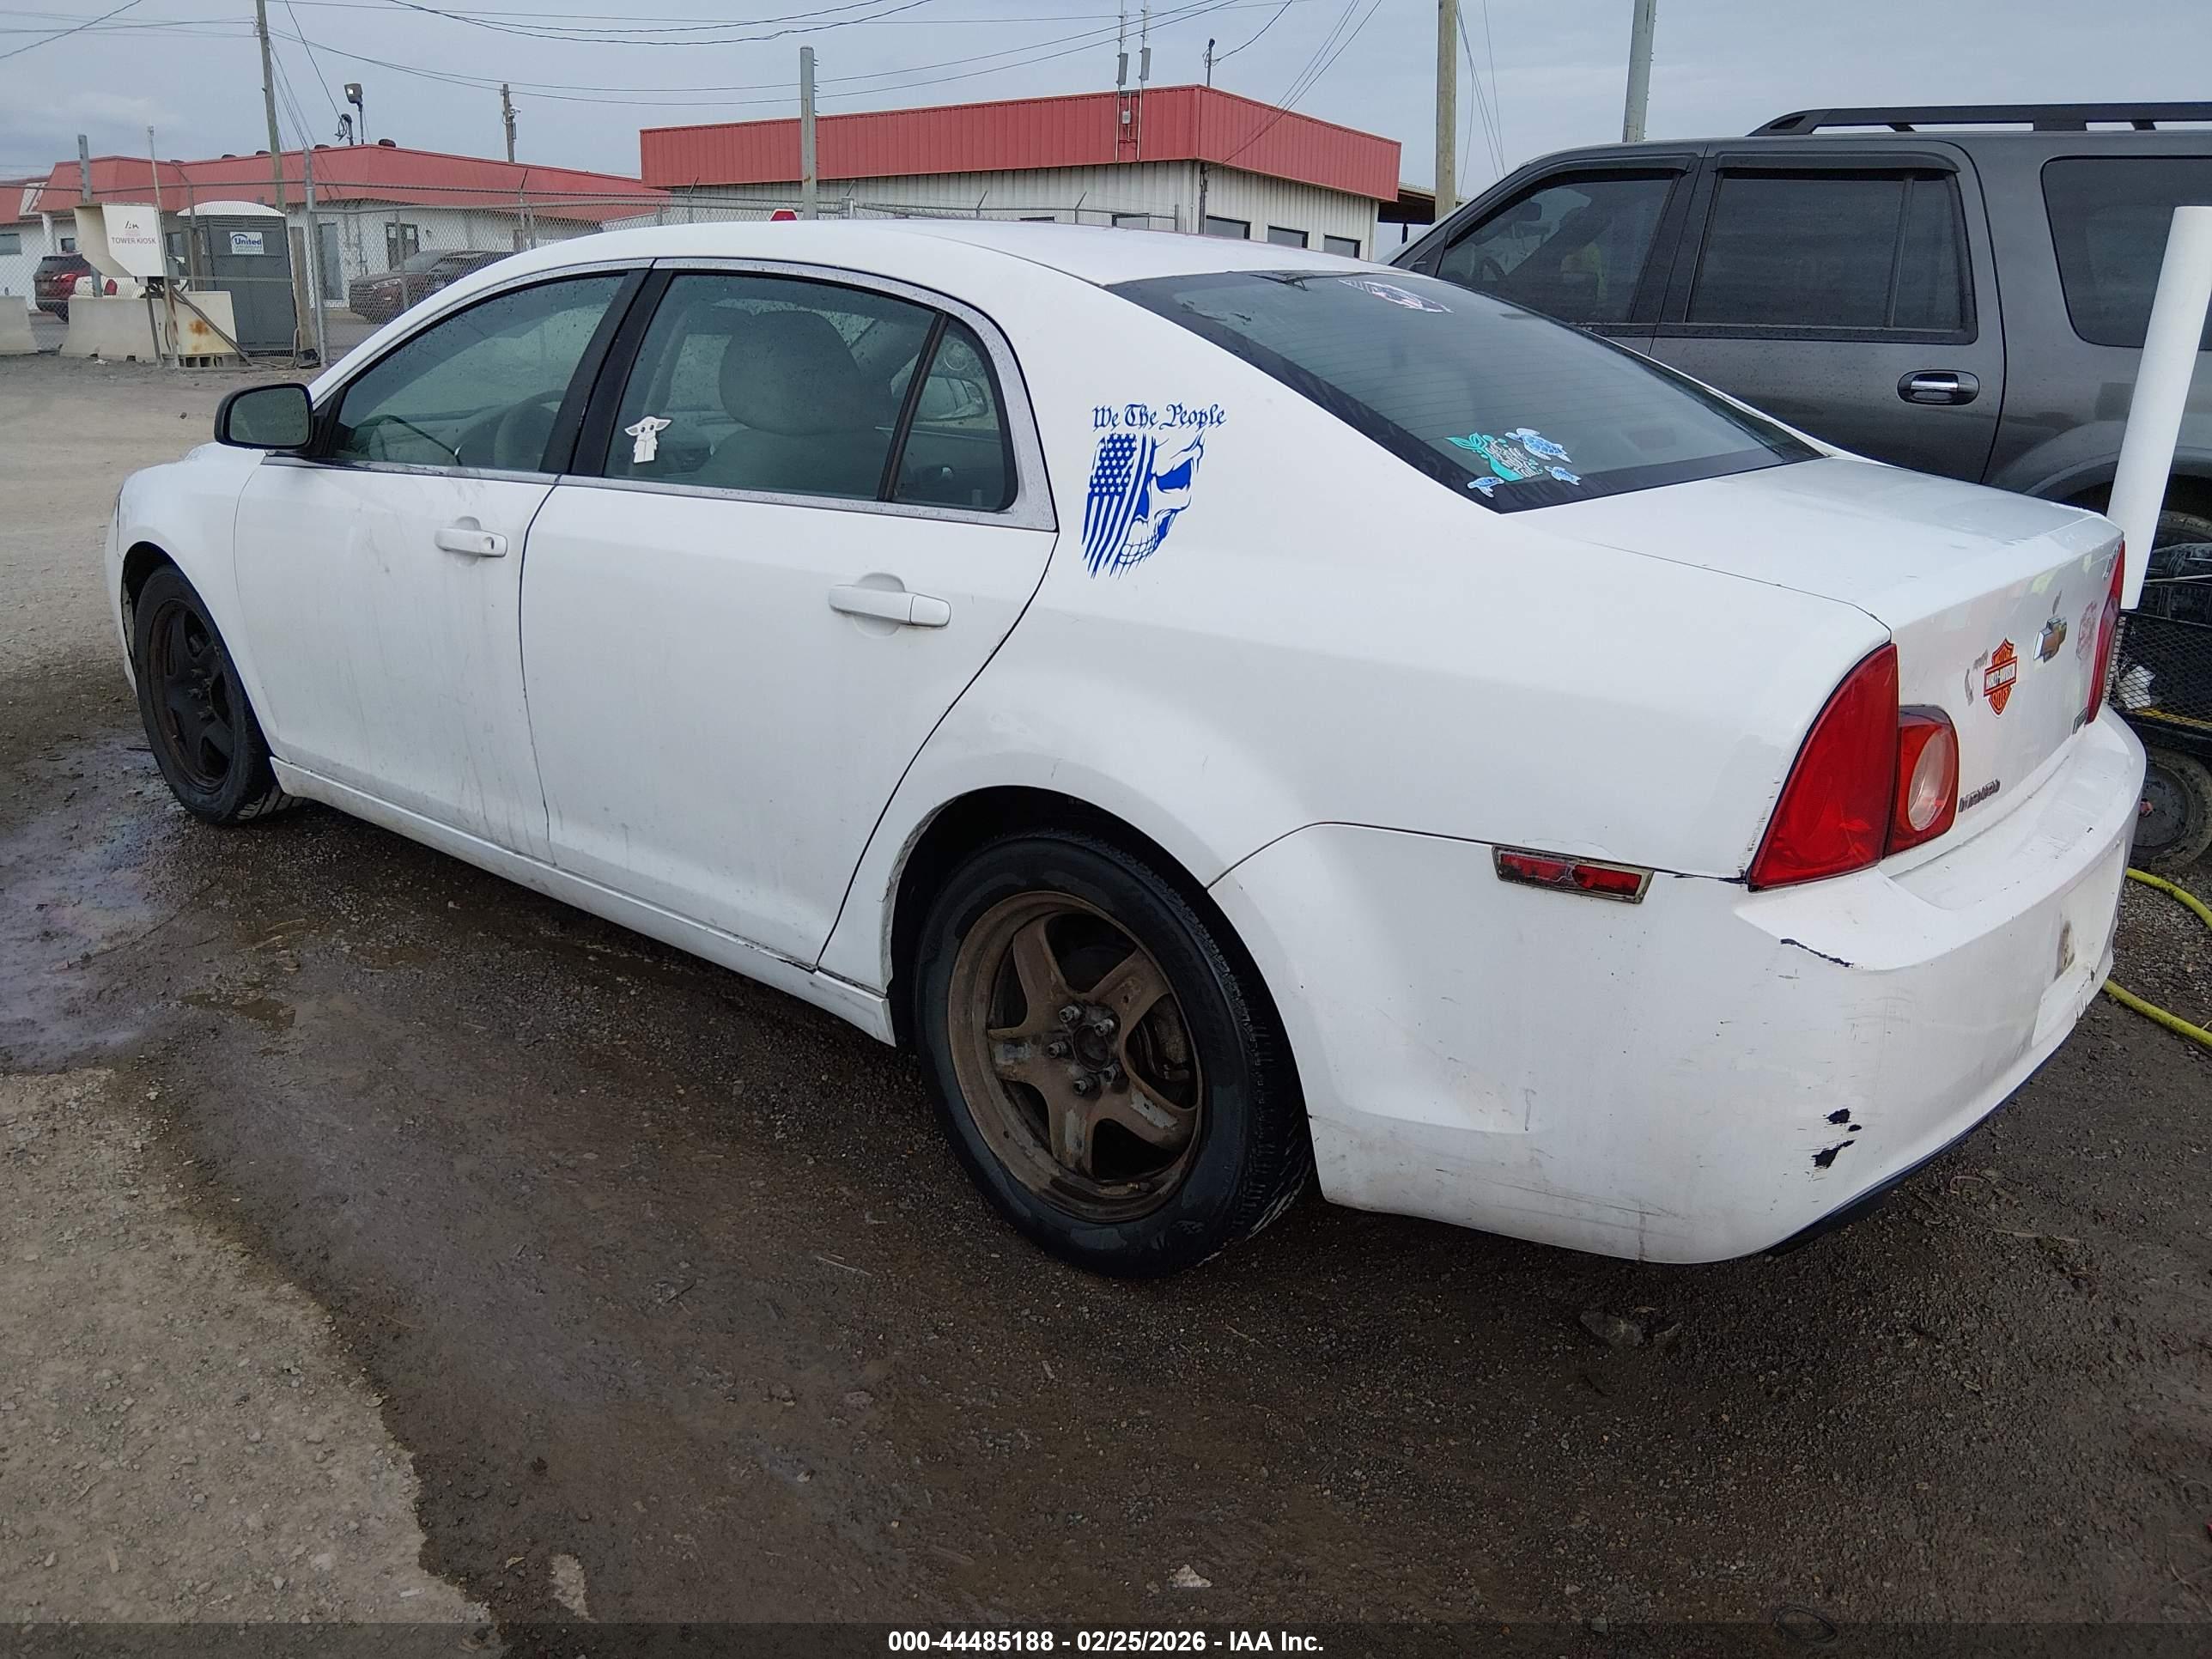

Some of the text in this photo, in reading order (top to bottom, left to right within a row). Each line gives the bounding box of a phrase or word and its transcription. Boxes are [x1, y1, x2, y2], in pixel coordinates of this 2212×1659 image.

[1092, 402, 1227, 432] We The People
